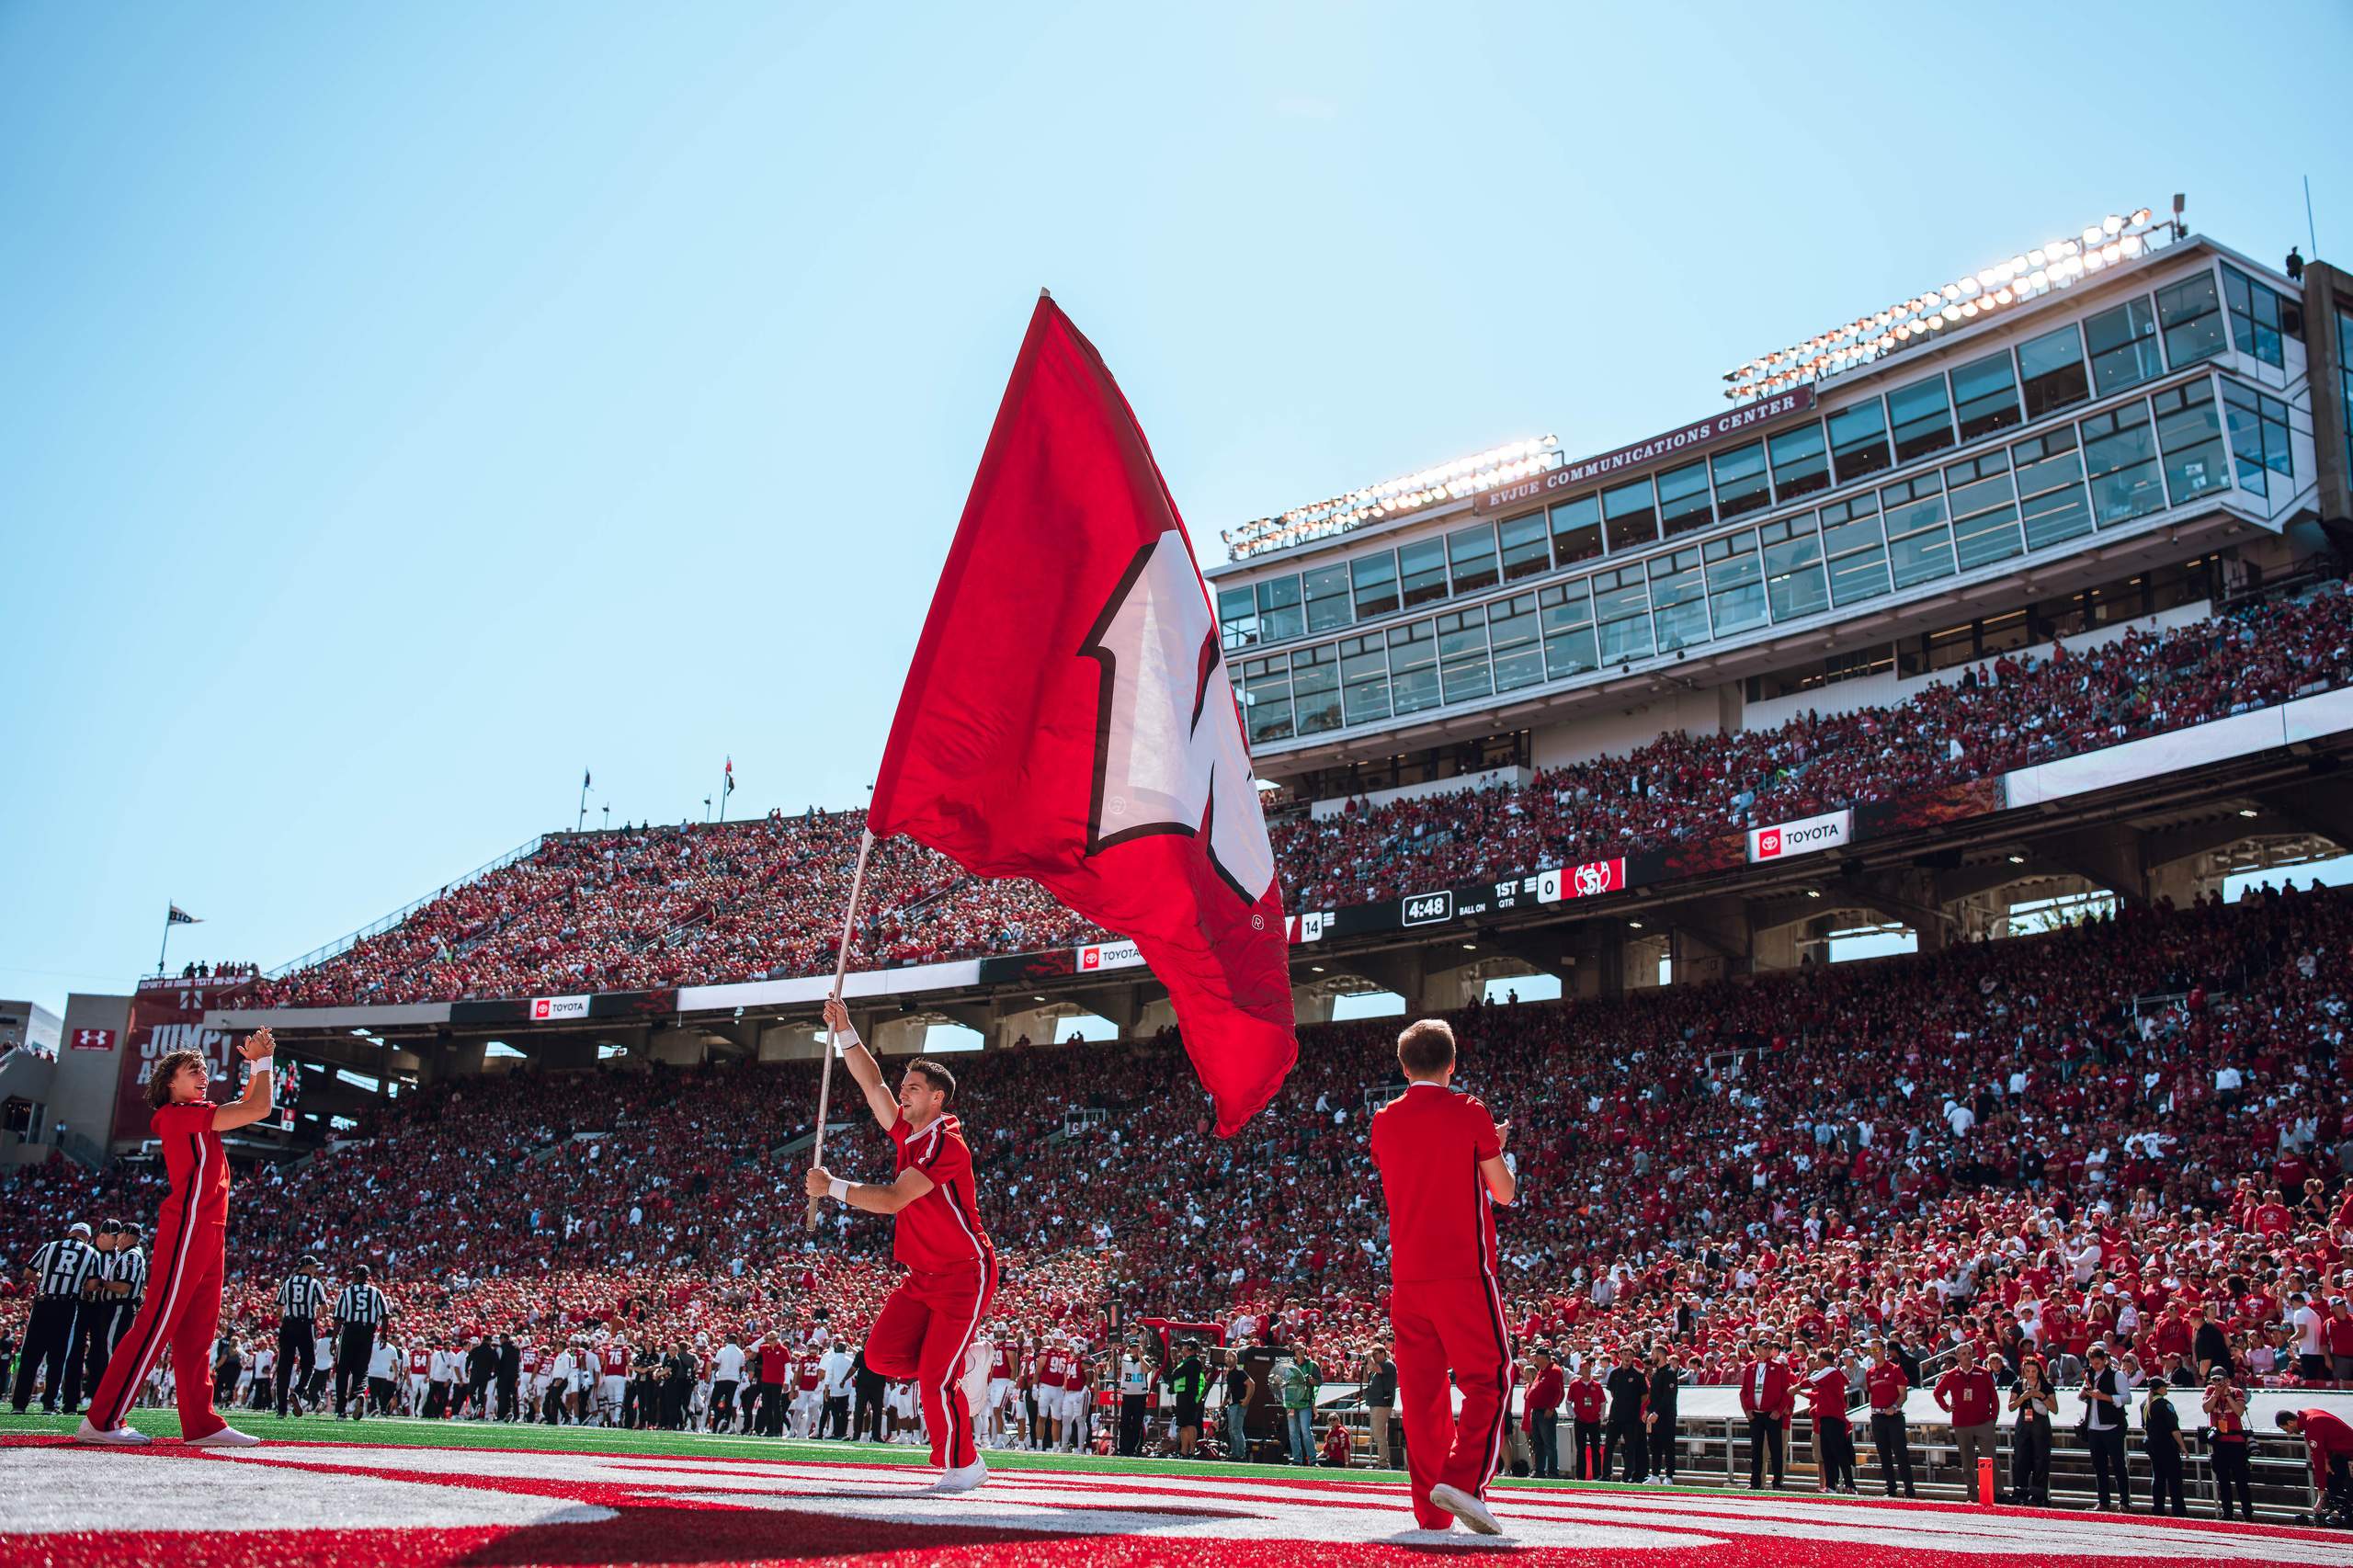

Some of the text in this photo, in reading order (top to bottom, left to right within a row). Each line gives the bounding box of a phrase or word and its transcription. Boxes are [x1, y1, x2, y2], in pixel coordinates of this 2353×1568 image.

[1489, 395, 1796, 506] EVJUE COMMUNICATIONS CENTER
[1786, 824, 1838, 845] TOYOTA
[1495, 881, 1518, 898] 1ST
[1545, 880, 1553, 895] 0
[1408, 897, 1444, 918] 4:48
[1459, 903, 1485, 916] BALL ON
[1498, 898, 1515, 908] QTR
[1305, 921, 1319, 934] 14
[1103, 949, 1140, 961] TOYOTA
[552, 1003, 583, 1012] TOYOTA
[1073, 1122, 1079, 1132] C
[55, 1249, 79, 1275] R
[292, 1284, 304, 1303] B
[356, 1292, 368, 1311] S
[414, 1355, 427, 1368] 64
[608, 1351, 622, 1366] 76
[1050, 1357, 1066, 1374] 96
[804, 1362, 817, 1377] 23
